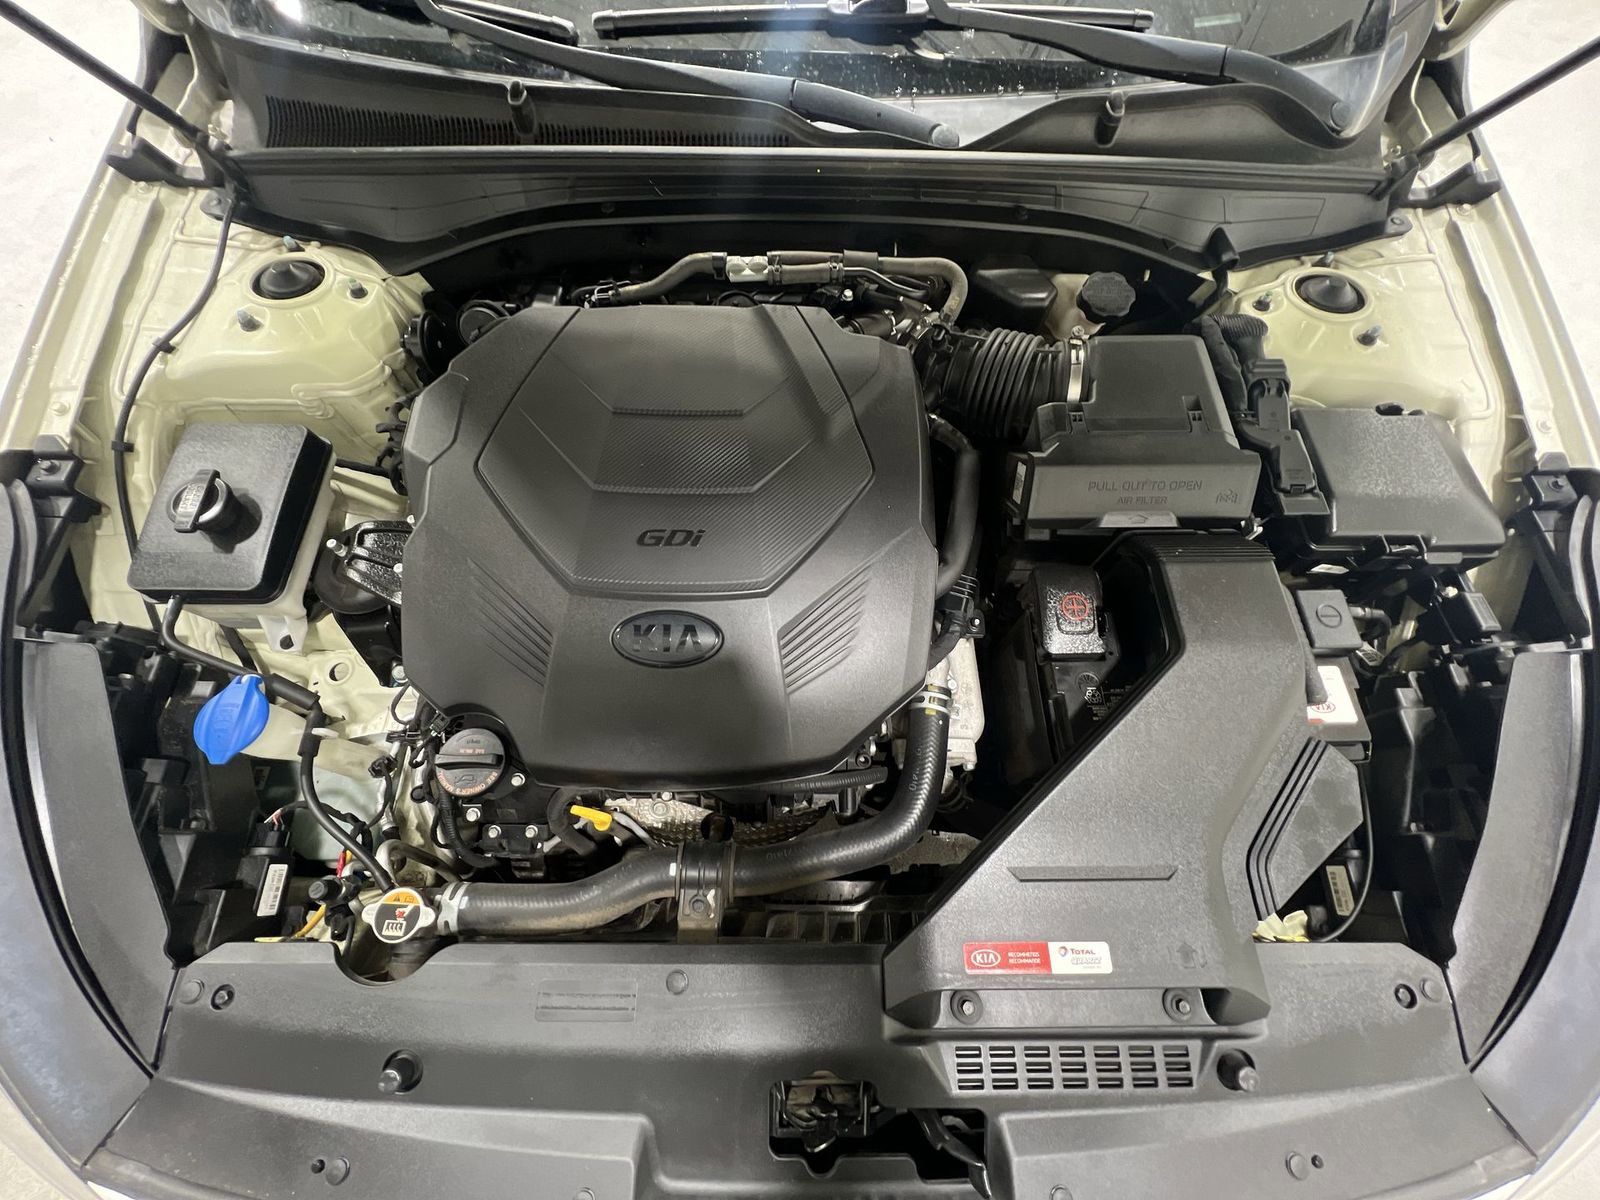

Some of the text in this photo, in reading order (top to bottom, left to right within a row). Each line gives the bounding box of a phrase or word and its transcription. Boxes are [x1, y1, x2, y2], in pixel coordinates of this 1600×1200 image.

[1088, 480, 1203, 492] PULL OUT TO OPEN
[1118, 496, 1168, 504] AIR FILTER
[636, 529, 706, 547] GDi
[632, 624, 703, 652] KIA
[976, 952, 996, 964] KIA
